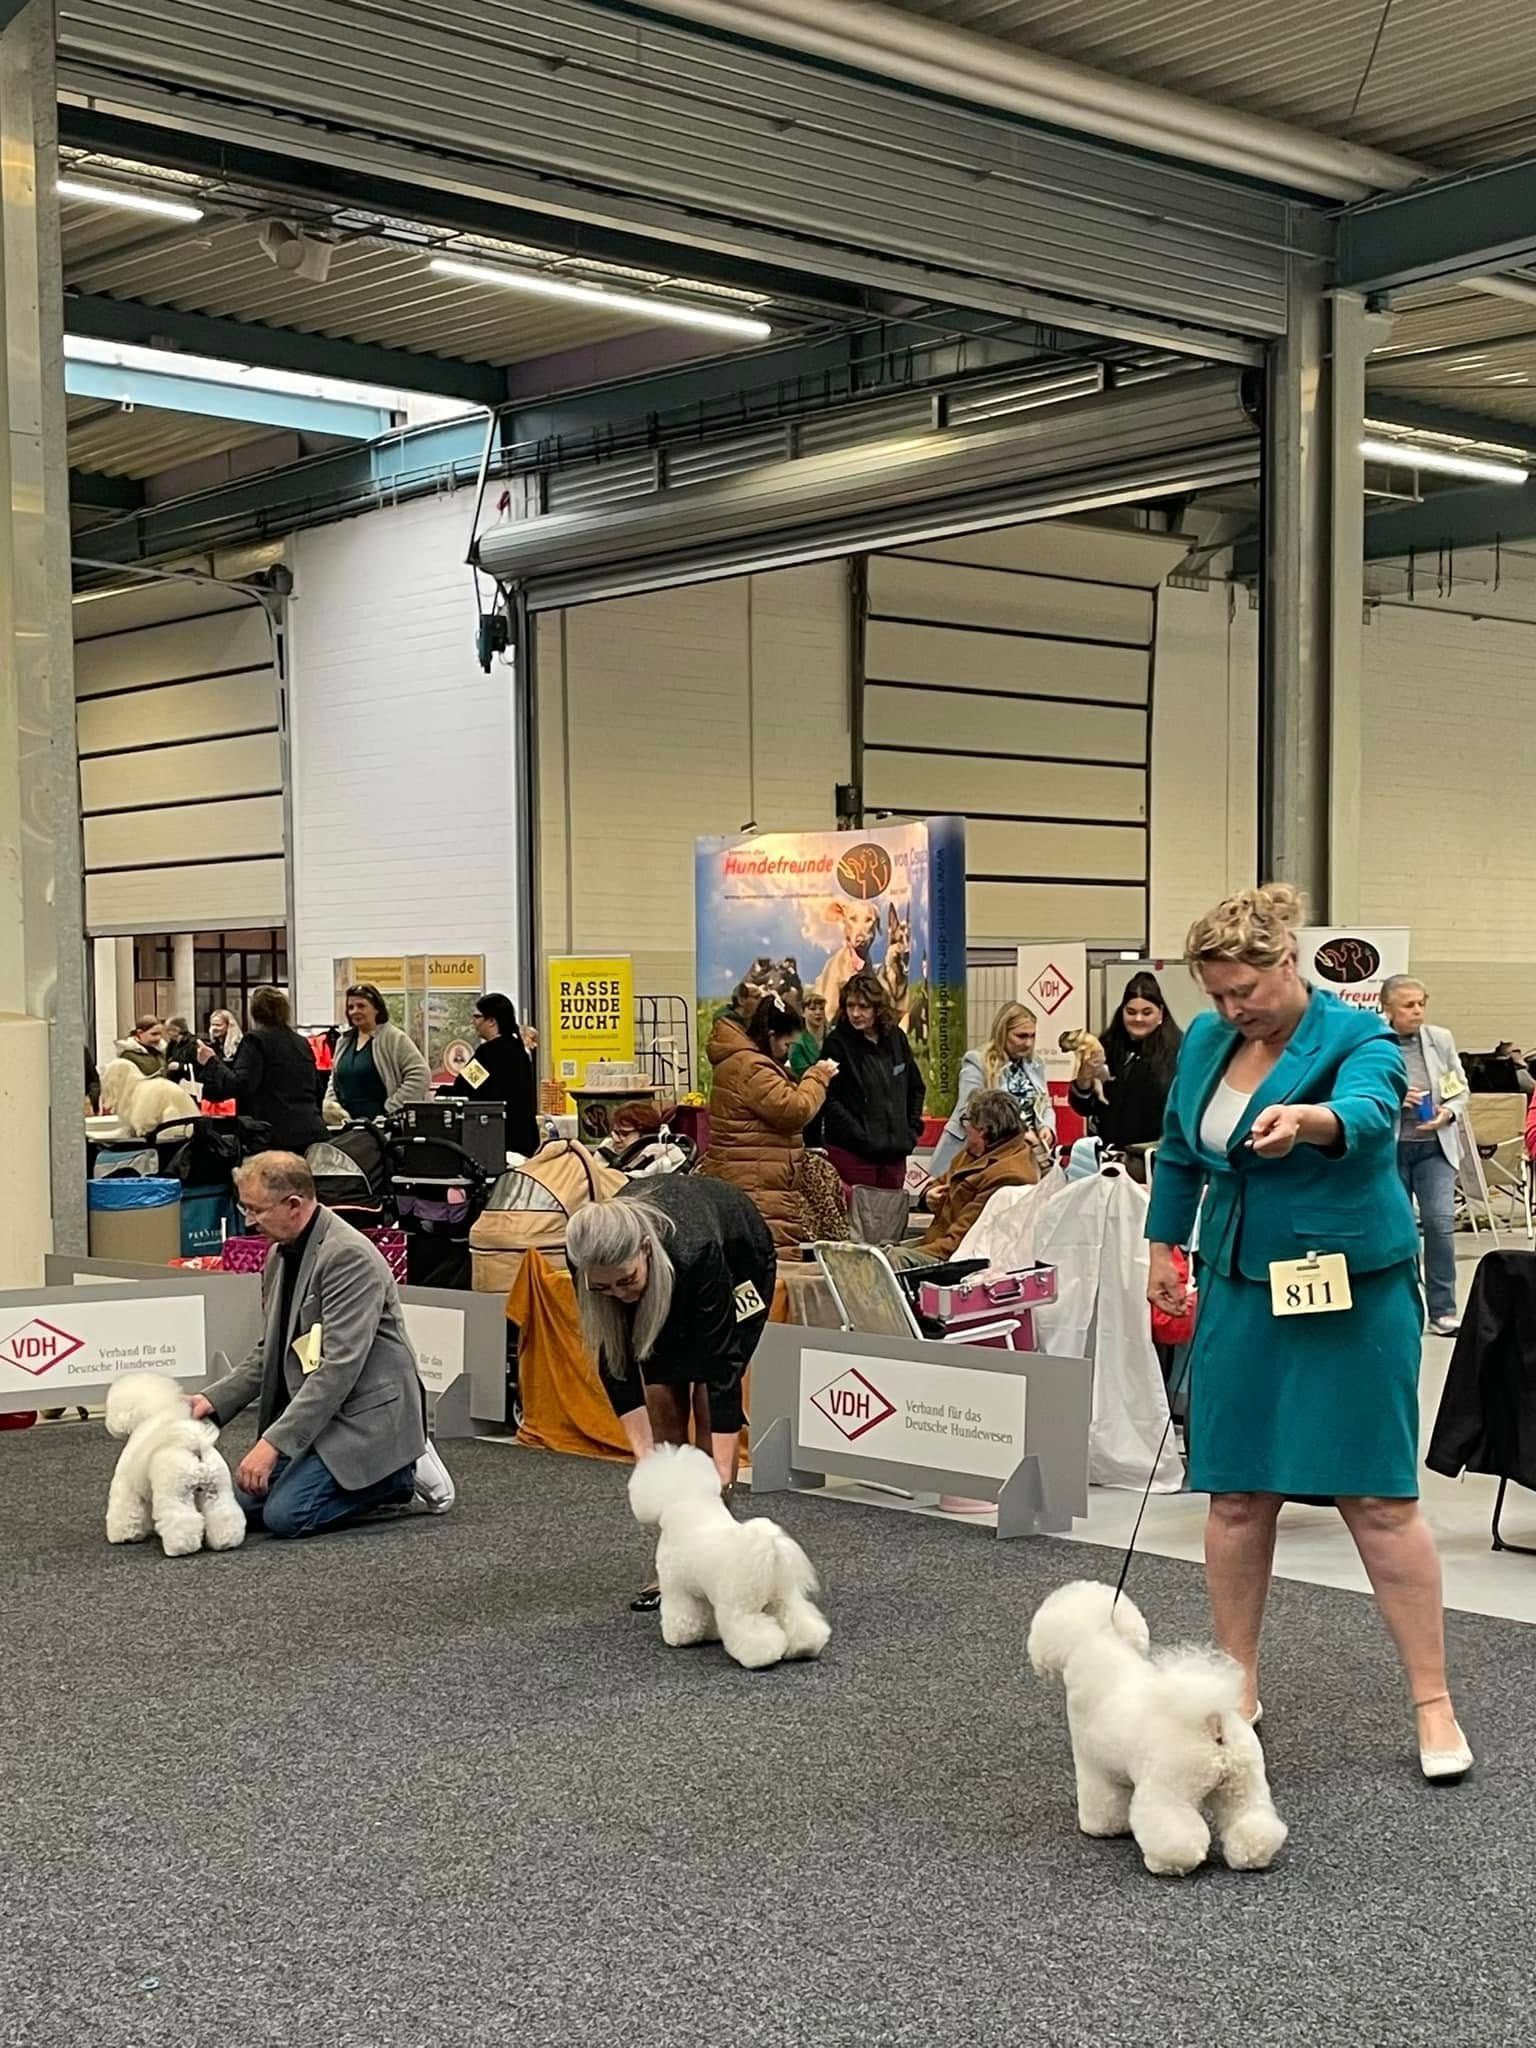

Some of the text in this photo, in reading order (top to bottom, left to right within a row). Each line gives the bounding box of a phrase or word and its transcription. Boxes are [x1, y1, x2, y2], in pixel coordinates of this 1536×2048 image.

[725, 853, 834, 876] Hundefreunde
[428, 959, 474, 974] shunde
[560, 981, 620, 996] RASSE
[1039, 980, 1060, 998] VDH
[560, 998, 620, 1013] HUNDE
[560, 1016, 620, 1030] ZUCHT
[735, 1290, 760, 1314] 08
[1286, 1280, 1333, 1308] 811
[11, 1335, 57, 1359] VDH
[99, 1343, 177, 1359] Verband für das
[67, 1357, 177, 1375] Deutsche Hundewesen
[829, 1388, 870, 1420] VDH
[905, 1400, 982, 1423] Verband für das
[905, 1416, 1013, 1446] Deutsche Hundewesen
